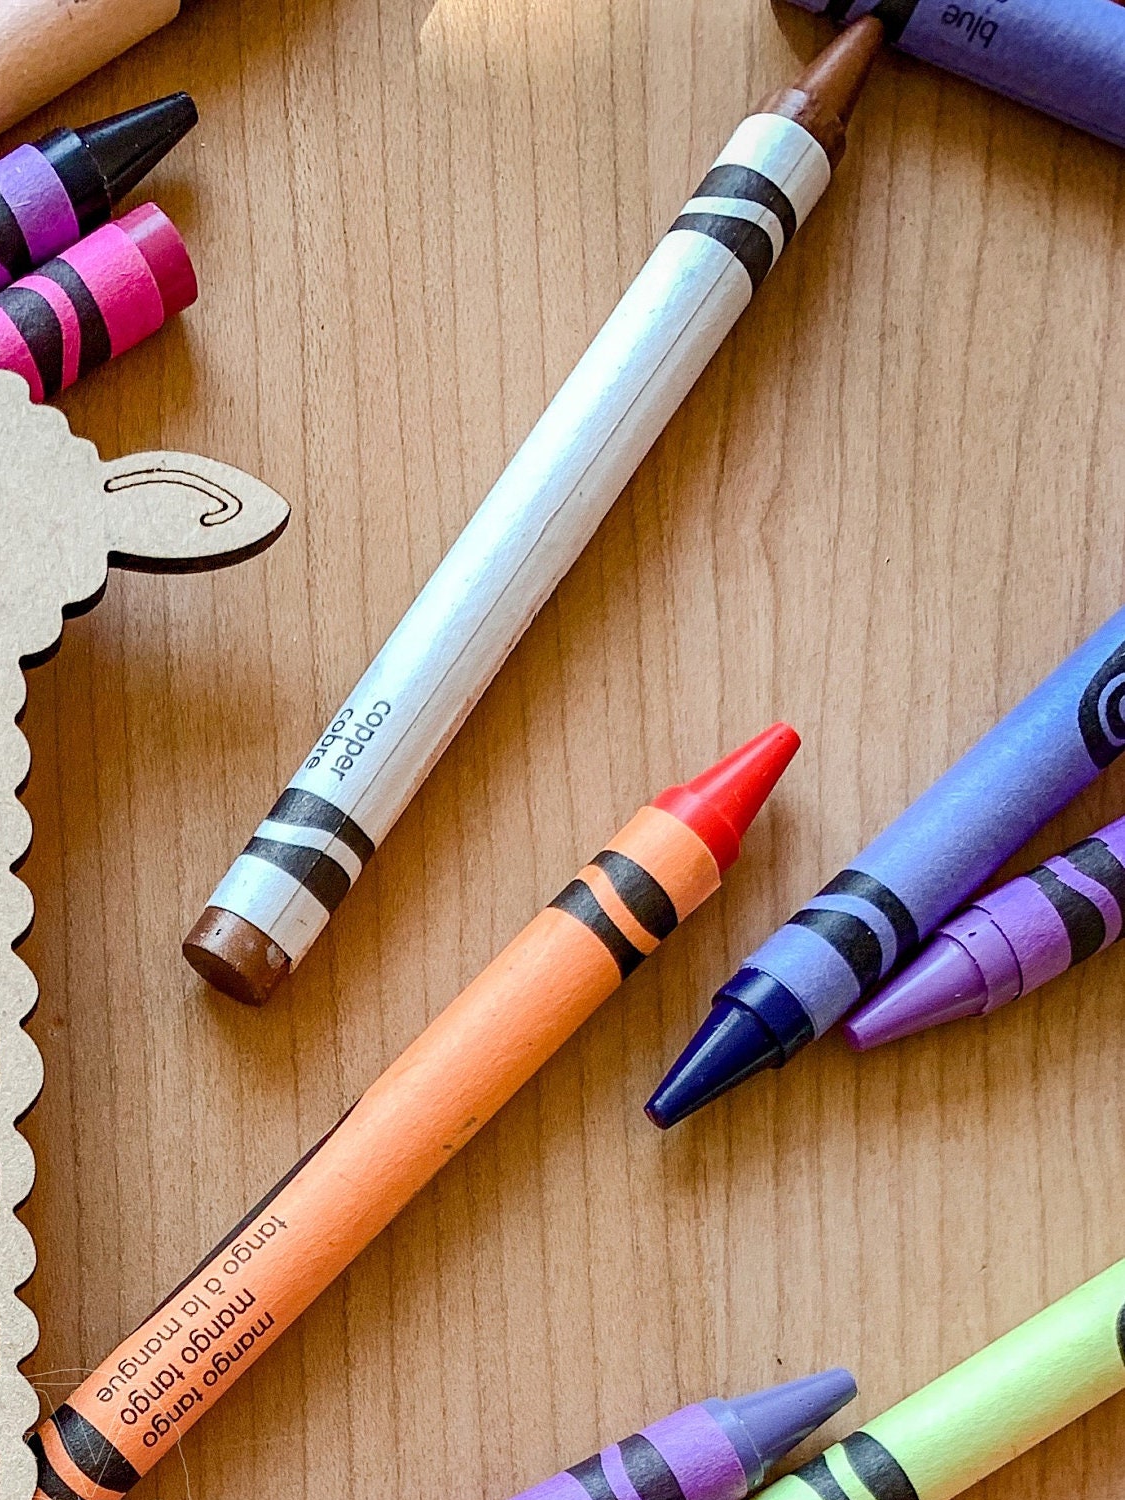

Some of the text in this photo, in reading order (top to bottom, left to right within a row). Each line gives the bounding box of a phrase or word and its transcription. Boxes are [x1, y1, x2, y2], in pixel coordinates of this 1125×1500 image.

[941, 4, 999, 48] blue
[305, 708, 354, 769] cobre
[330, 700, 391, 781] copper
[96, 1215, 288, 1402] tango à la mangue
[120, 1288, 256, 1425] mango tango
[142, 1311, 275, 1448] mango tango
